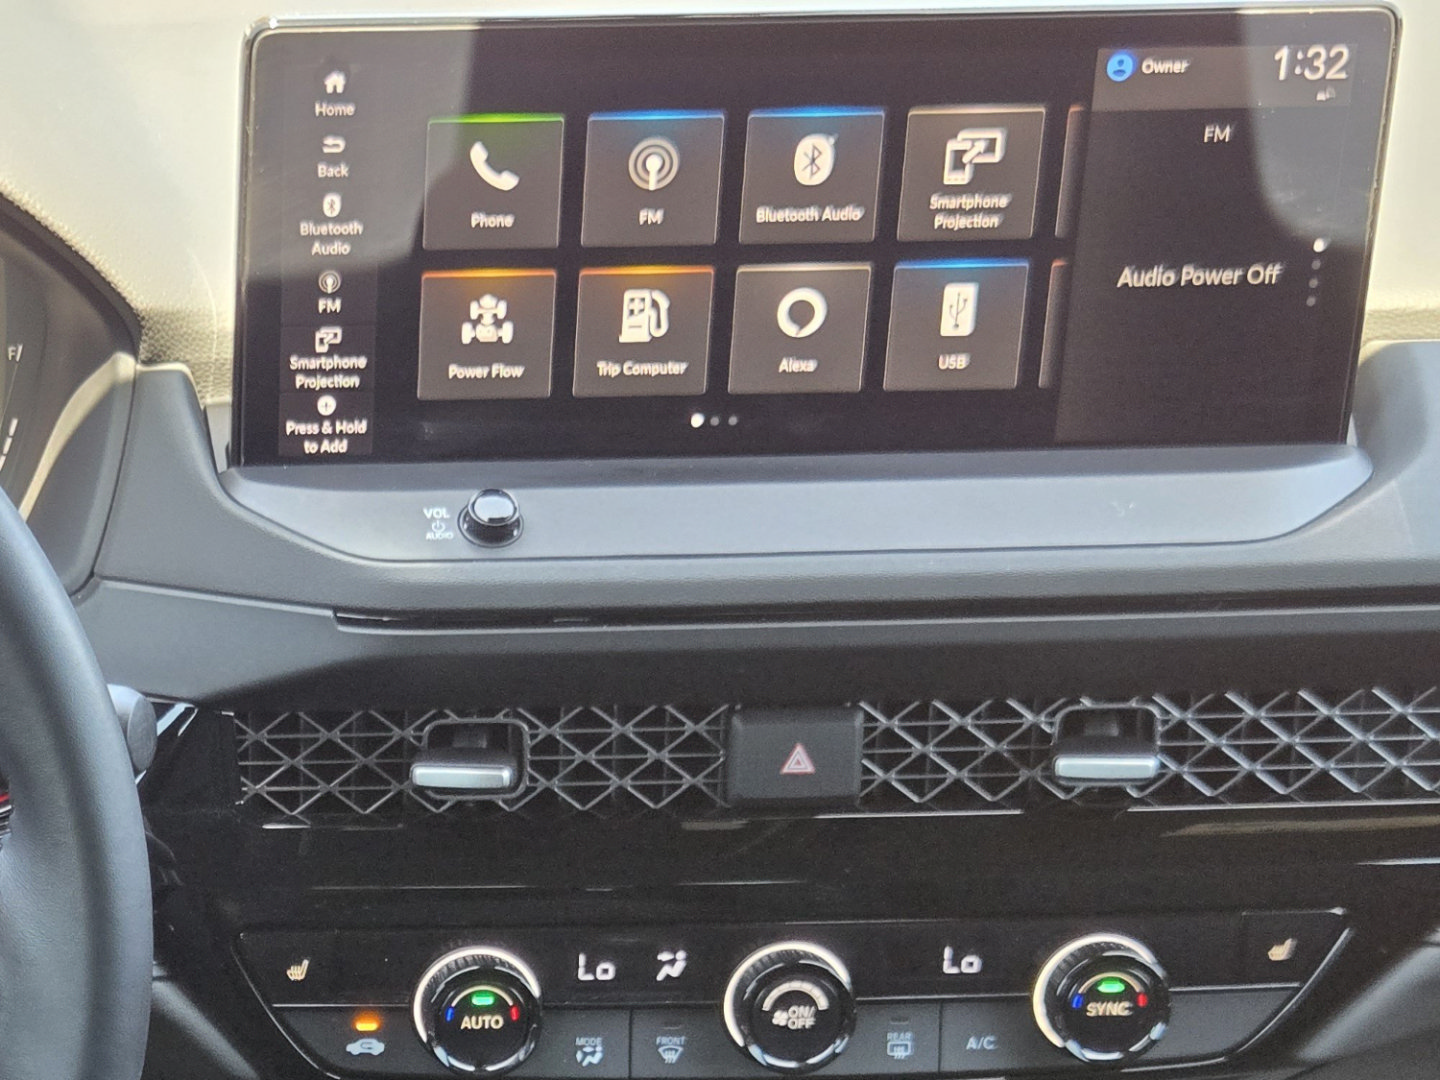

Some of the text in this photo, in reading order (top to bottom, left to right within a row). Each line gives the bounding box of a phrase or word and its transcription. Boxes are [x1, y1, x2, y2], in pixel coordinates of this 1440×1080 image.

[1141, 58, 1188, 73] Owner
[1274, 44, 1350, 81] 1:32
[315, 102, 355, 117] Home
[1204, 125, 1232, 143] FM
[317, 163, 349, 178] Back
[929, 194, 1009, 211] Smartphone
[471, 213, 513, 228] Phone
[639, 209, 663, 225] FM
[756, 206, 862, 223] Bluetooth Audio
[934, 213, 1000, 230] Projection
[300, 221, 363, 236] Bluetooth
[311, 241, 351, 256] Audio
[1117, 262, 1282, 288] Audio Power Off
[318, 299, 341, 314] FM
[289, 355, 367, 373] Smartphone
[597, 360, 688, 378] Trip Computer
[778, 358, 817, 373] Alexa
[938, 355, 969, 370] USB
[448, 363, 524, 379] Power Flow
[295, 374, 360, 391] Projection
[286, 420, 367, 435] Press & Hold
[304, 440, 348, 454] to Add
[423, 508, 450, 519] VOL
[943, 945, 983, 974] Lo
[577, 954, 616, 981] Lo
[788, 1005, 814, 1018] ON/
[1086, 1002, 1132, 1017] SYNC
[461, 1015, 504, 1031] AUTO
[788, 1017, 814, 1029] OFF
[575, 1037, 603, 1048] MODE
[656, 1036, 685, 1047] FRONT
[886, 1032, 912, 1042] REAR
[966, 1036, 996, 1051] A/C
